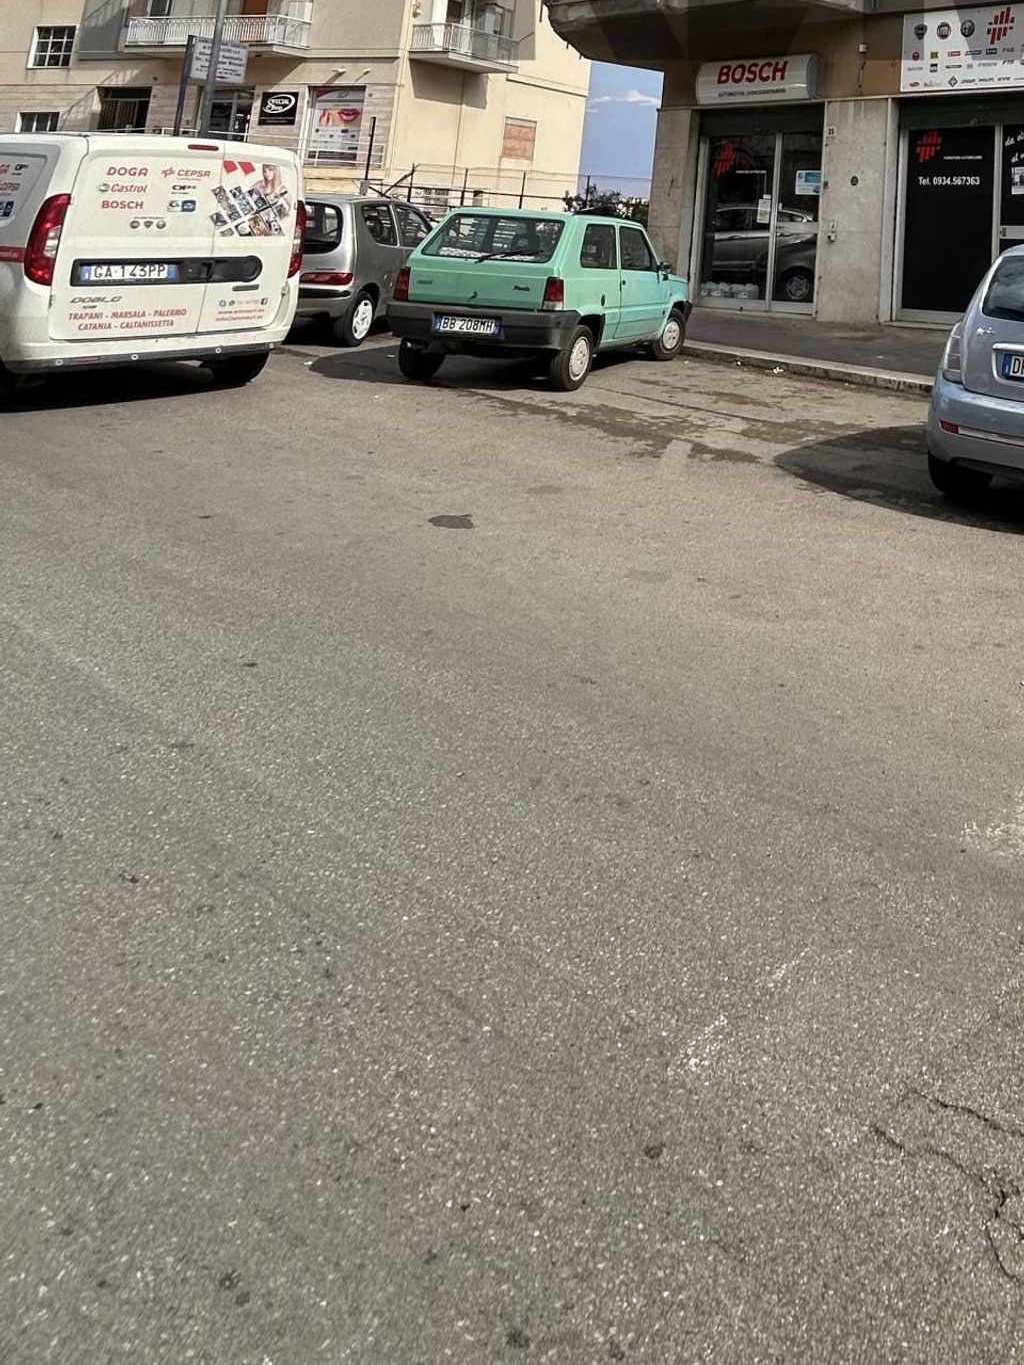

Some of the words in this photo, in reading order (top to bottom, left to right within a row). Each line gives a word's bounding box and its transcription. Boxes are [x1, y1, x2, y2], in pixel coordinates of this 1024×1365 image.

[717, 60, 788, 84] BOSCH
[106, 167, 149, 177] DOGA
[177, 169, 211, 178] CEPSA
[918, 176, 931, 185] Tel.
[110, 183, 148, 193] Castrol
[101, 200, 144, 209] BOSCH
[94, 265, 113, 278] GA
[69, 312, 103, 321] TRAPANI
[110, 310, 146, 319] MARSALA
[153, 309, 187, 317] PALERMO
[78, 322, 112, 330] CATANIA
[120, 320, 174, 329] CALTANISSETTA
[442, 317, 456, 330] BB
[459, 319, 493, 332] 208MH
